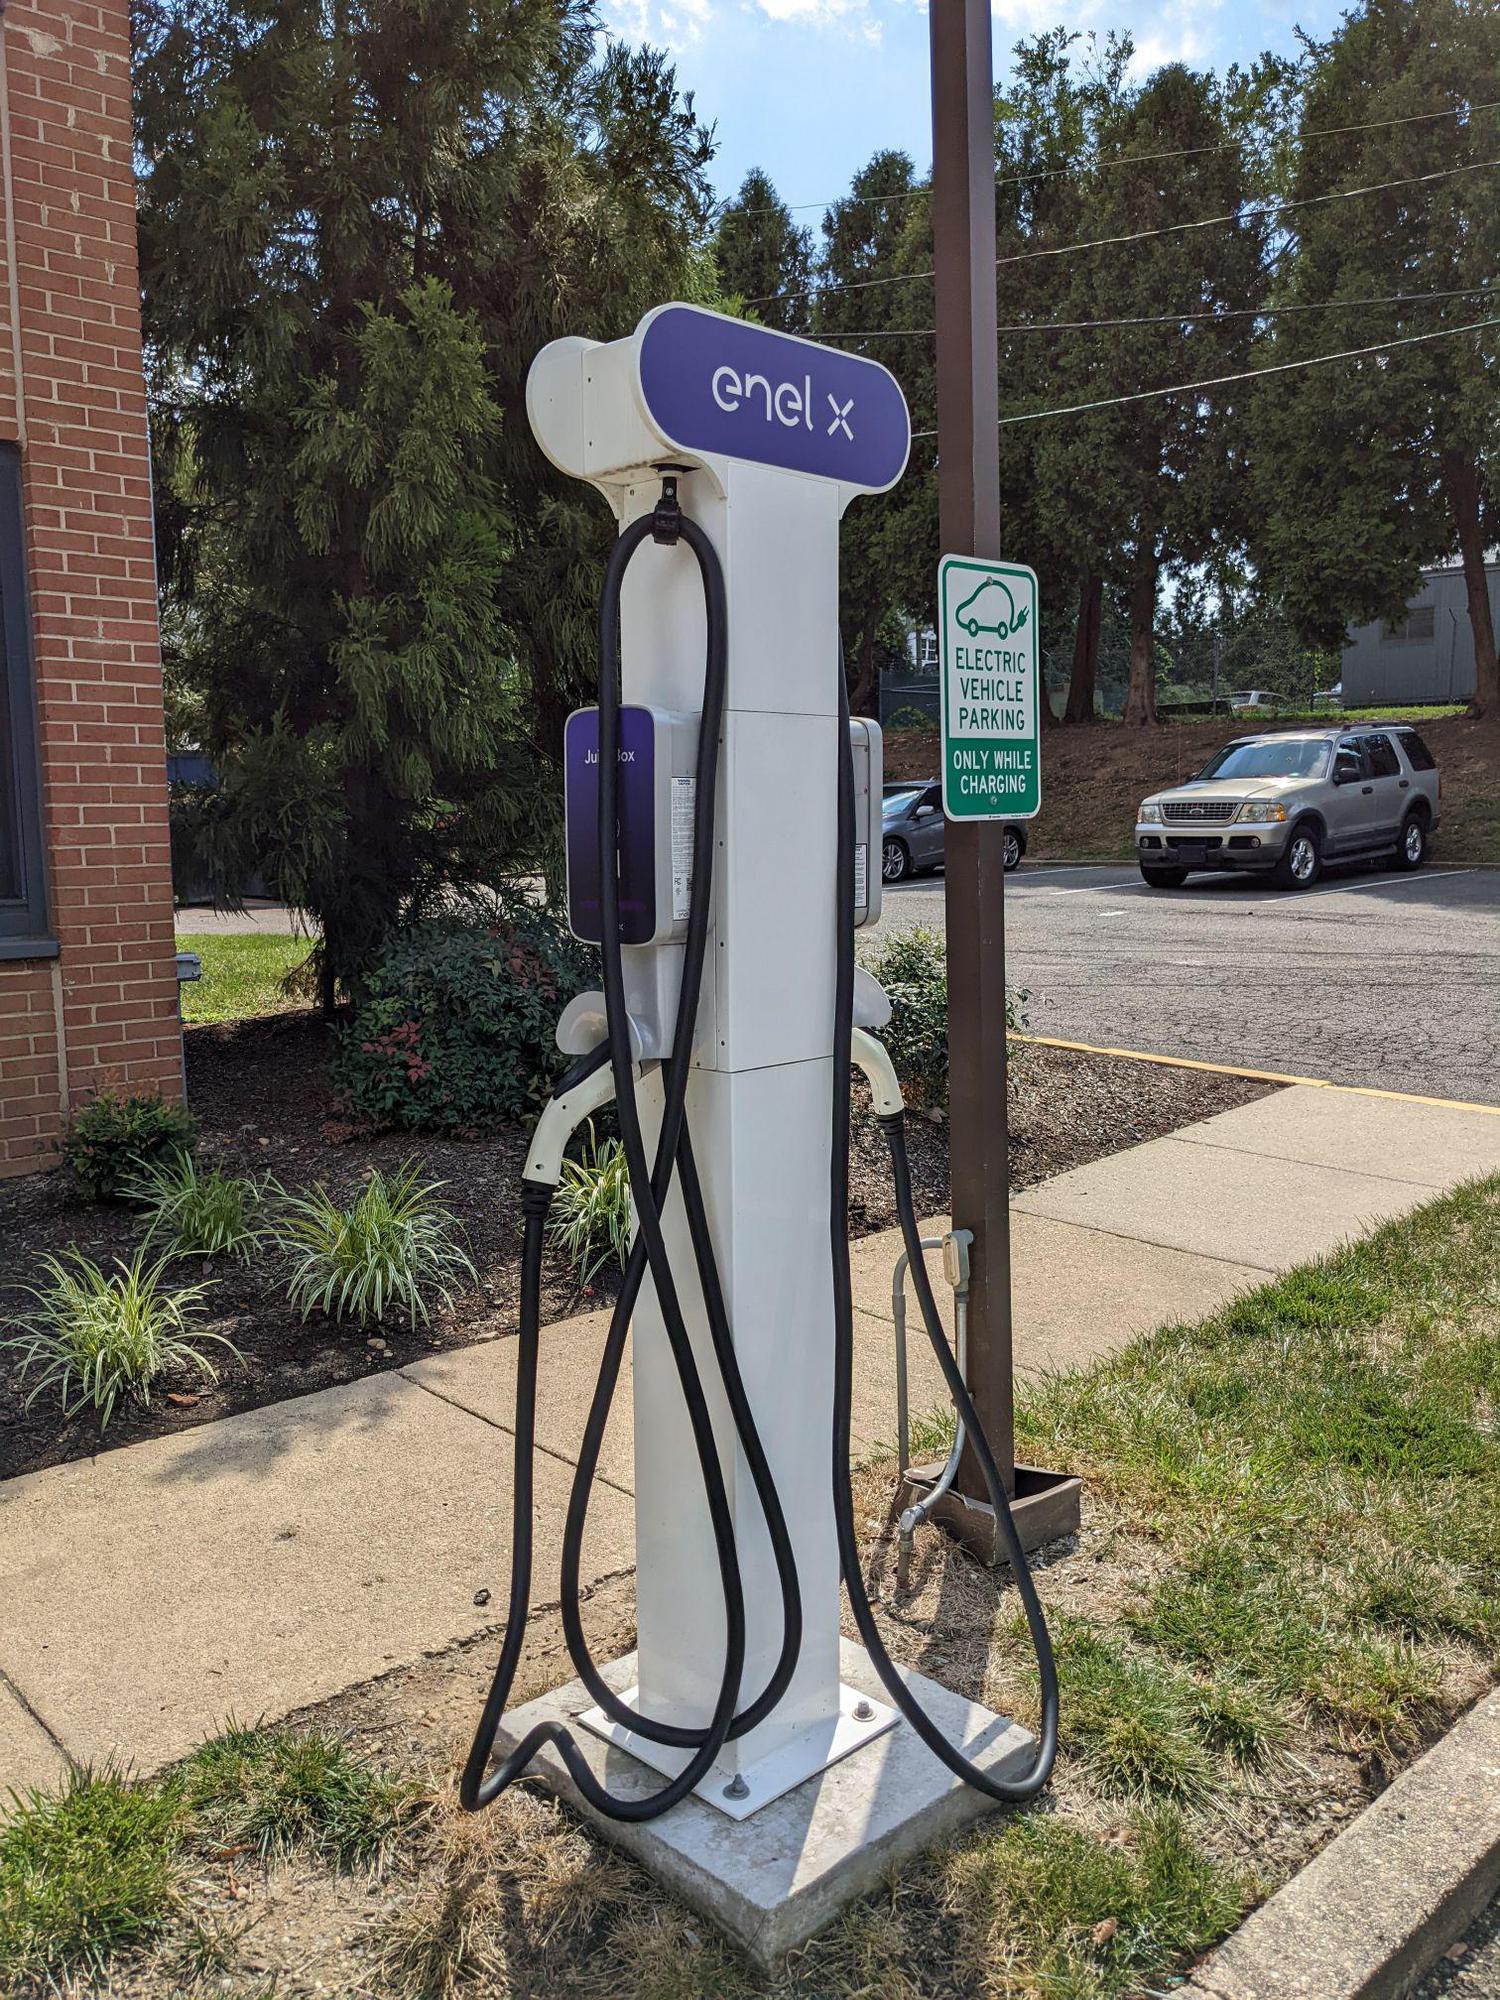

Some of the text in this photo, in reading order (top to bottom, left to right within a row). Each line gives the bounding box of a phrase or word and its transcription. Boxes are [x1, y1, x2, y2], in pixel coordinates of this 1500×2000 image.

[712, 366, 854, 441] enel x
[956, 647, 1026, 673] ELECTRIC
[960, 677, 1023, 702] VEHICLE
[959, 707, 1025, 731] PARKING
[584, 748, 635, 764] Juiox
[953, 750, 1031, 770] ONLY WHILE
[960, 775, 1026, 794] CHARGING
